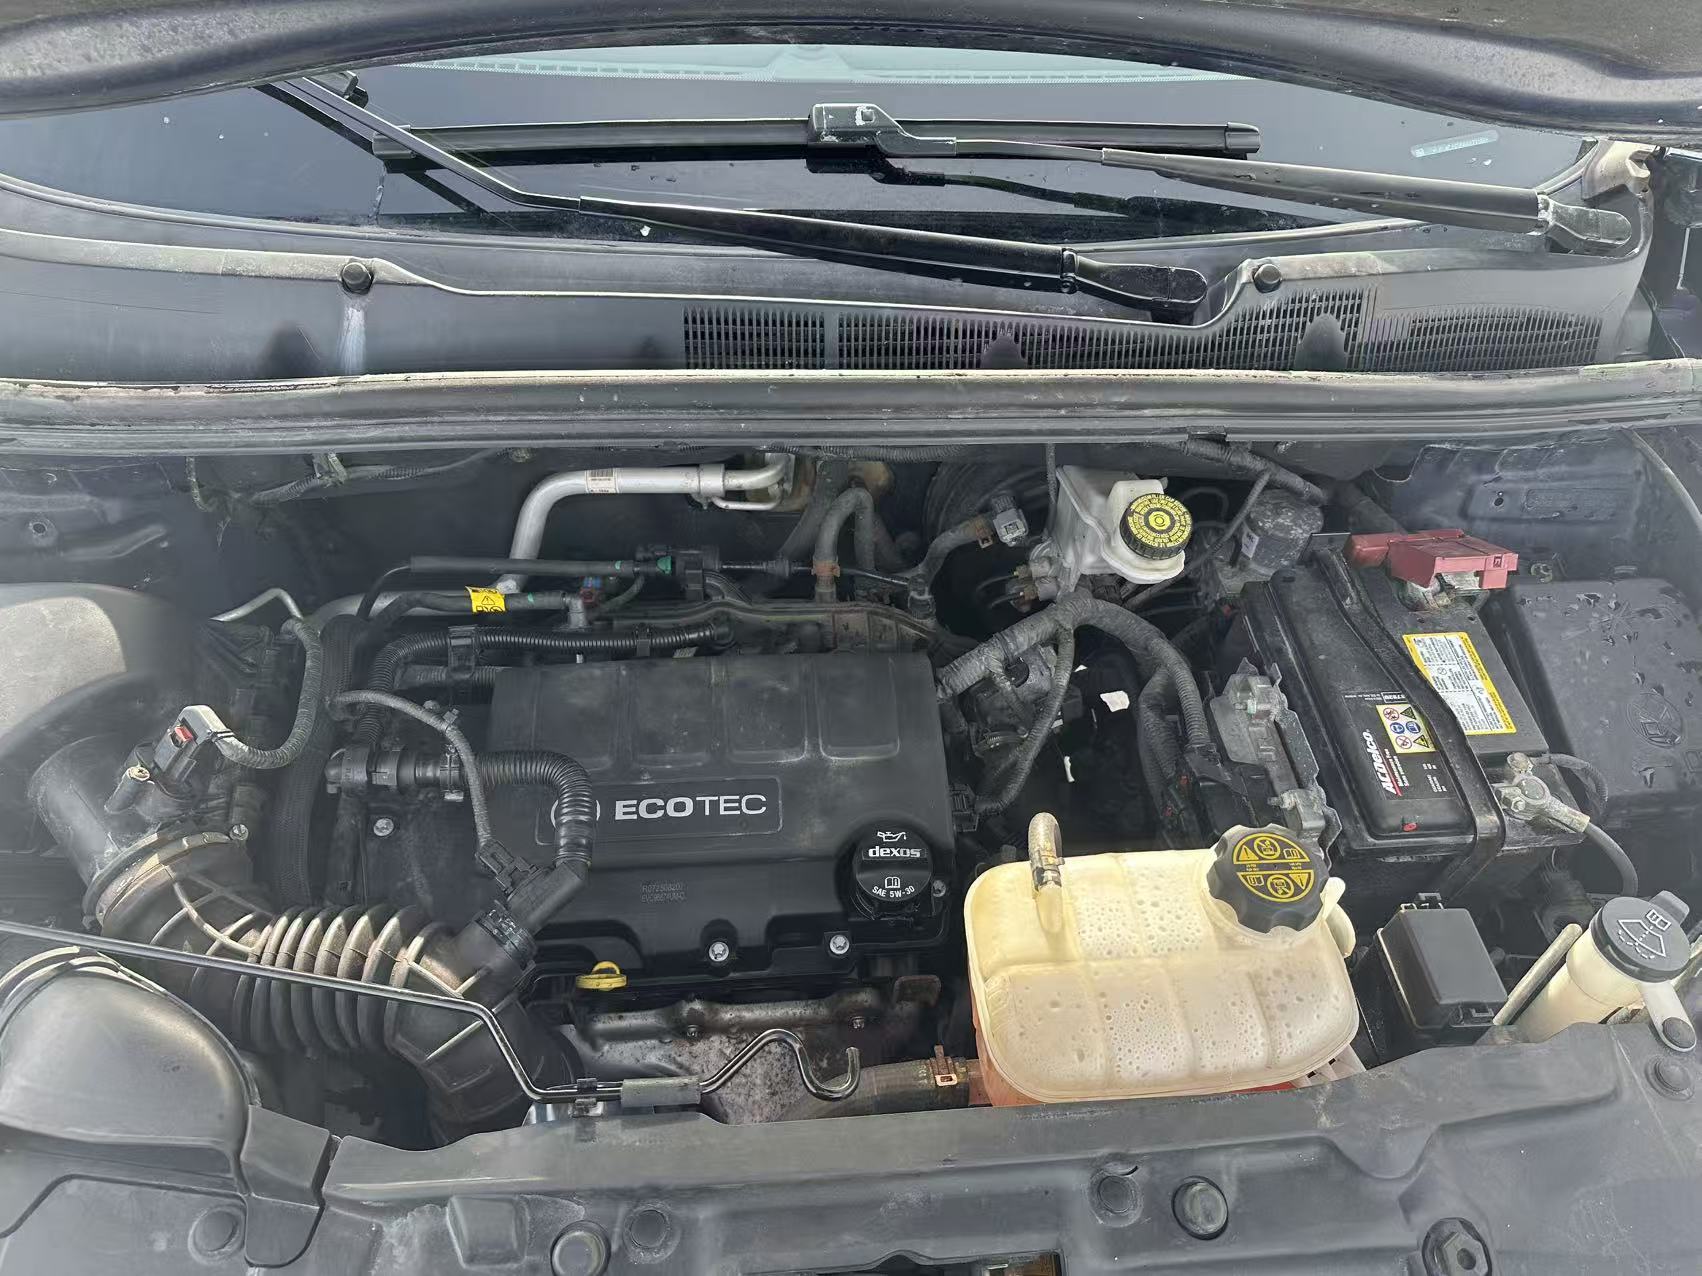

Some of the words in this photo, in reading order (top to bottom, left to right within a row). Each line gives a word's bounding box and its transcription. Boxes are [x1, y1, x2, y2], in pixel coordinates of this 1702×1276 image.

[1362, 731, 1397, 795] ACDelco
[615, 794, 767, 820] ECOTEC
[868, 845, 922, 858] dexos
[872, 885, 887, 898] SAE
[889, 885, 915, 898] 5W-30
